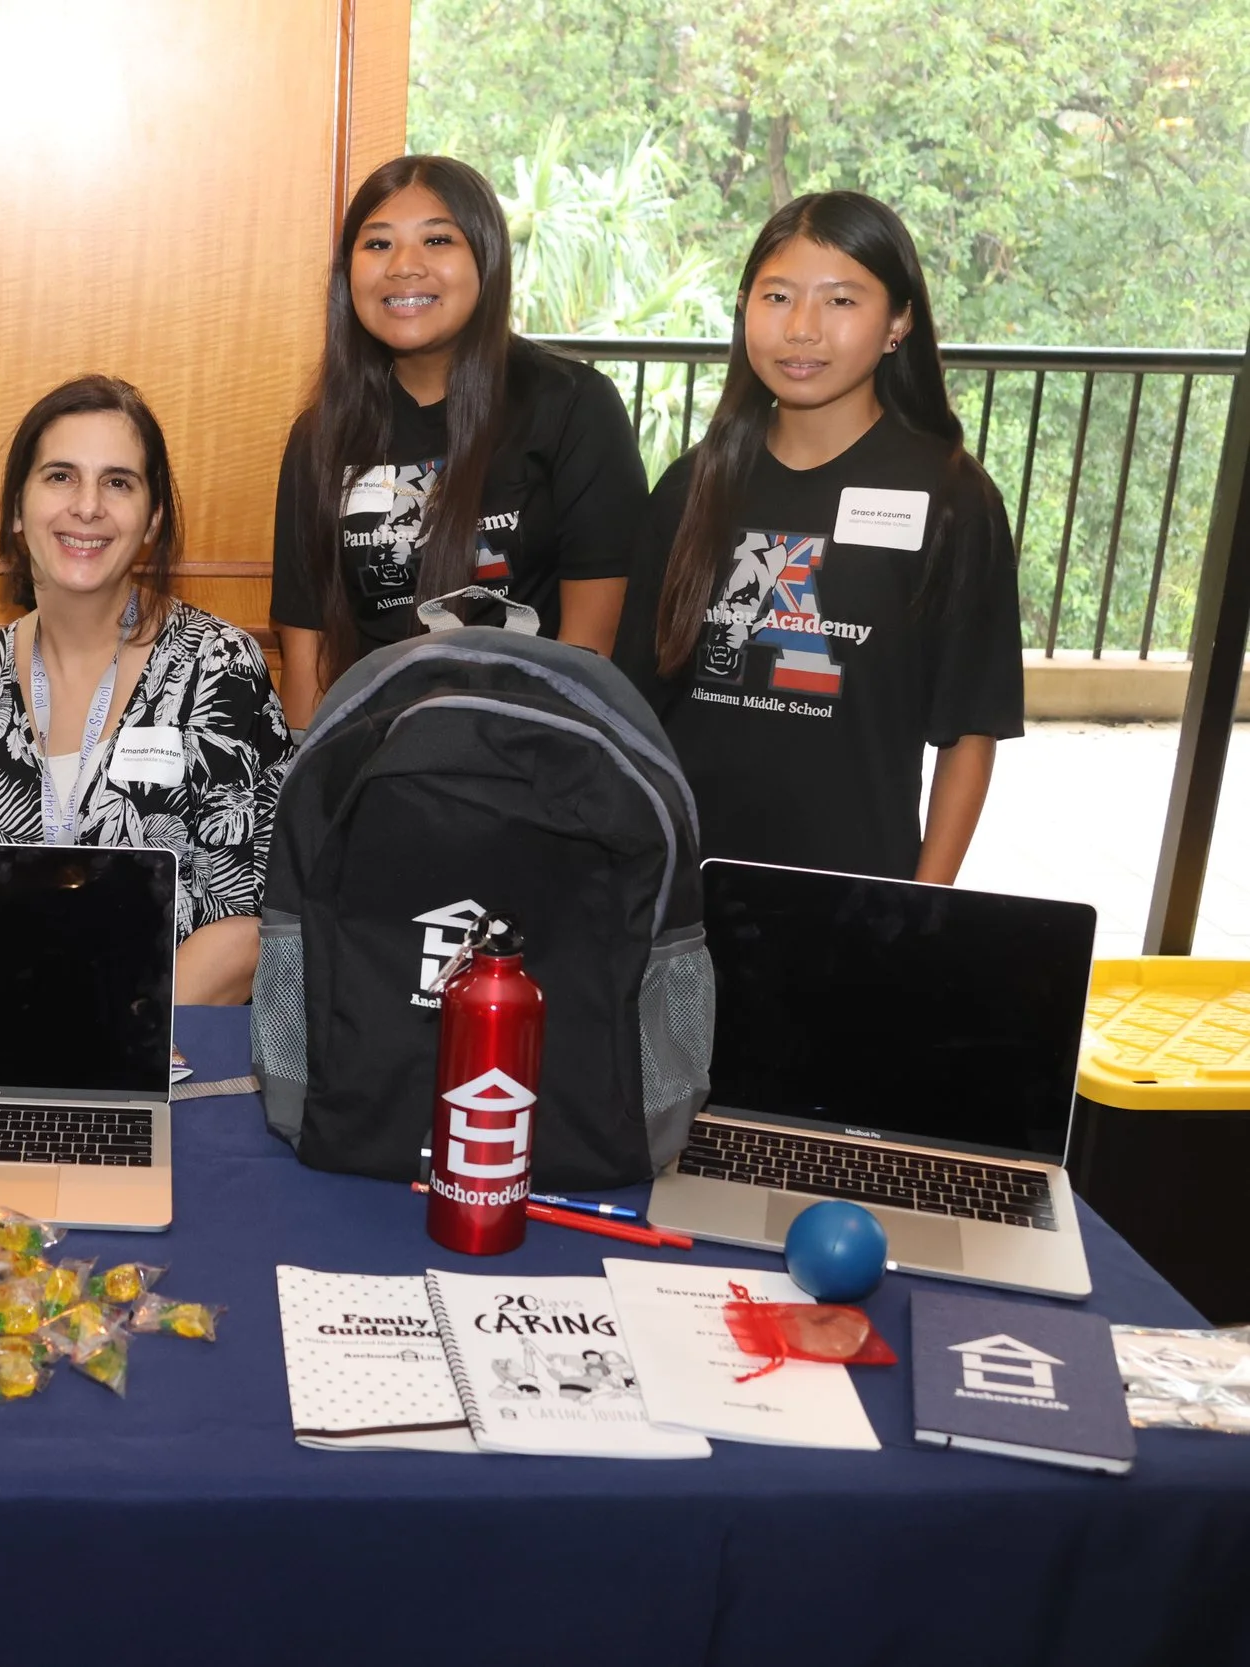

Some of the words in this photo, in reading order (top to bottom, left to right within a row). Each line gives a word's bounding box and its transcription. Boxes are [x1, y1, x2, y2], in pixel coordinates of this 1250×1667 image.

[850, 508, 876, 517] Grace
[876, 510, 911, 520] Kozuma
[343, 524, 419, 548] Panther
[377, 594, 416, 610] Aliama
[703, 602, 758, 626] nther
[762, 608, 872, 646] Academy
[33, 671, 48, 710] School
[89, 686, 112, 727] School
[691, 687, 740, 706] Aliamanu
[742, 695, 786, 712] Middle
[788, 701, 833, 718] School
[120, 747, 149, 755] Amanda
[149, 747, 181, 758] Pinkston
[429, 1169, 532, 1206] Anchored4Li
[494, 1294, 539, 1312] 20
[342, 1313, 429, 1328] Family
[474, 1313, 618, 1337] CARING
[317, 1325, 441, 1338] Guideboo
[591, 1407, 649, 1423] JOURNA
